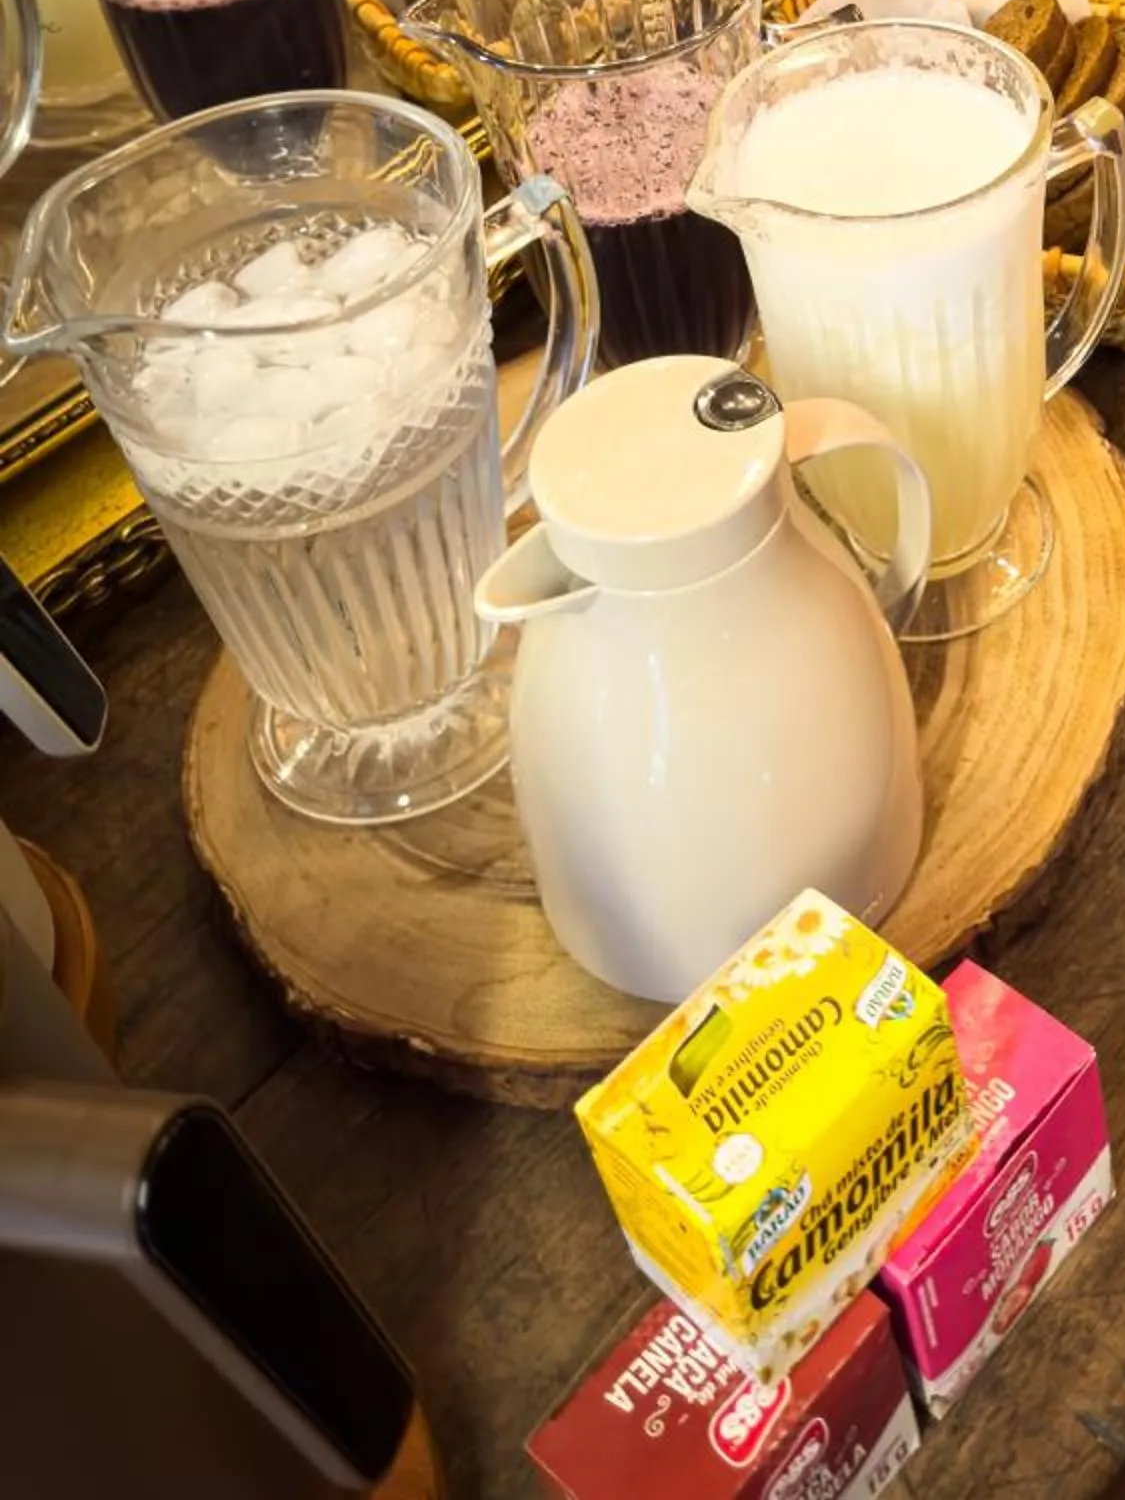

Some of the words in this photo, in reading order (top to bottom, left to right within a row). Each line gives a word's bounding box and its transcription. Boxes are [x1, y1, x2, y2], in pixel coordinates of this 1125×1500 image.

[702, 995, 843, 1135] Camomila
[726, 1017, 786, 1077] Gengibre
[768, 1060, 802, 1096] misto
[688, 1084, 717, 1118] Mel
[754, 1093, 770, 1112] de
[751, 1071, 955, 1311] Camomila
[799, 1189, 833, 1231] Chá
[835, 1136, 884, 1196] misto
[885, 1111, 906, 1140] de
[823, 1160, 911, 1266] Gengibre
[914, 1144, 925, 1163] e
[928, 1095, 960, 1148] Mel
[602, 1314, 698, 1413] CANELA
